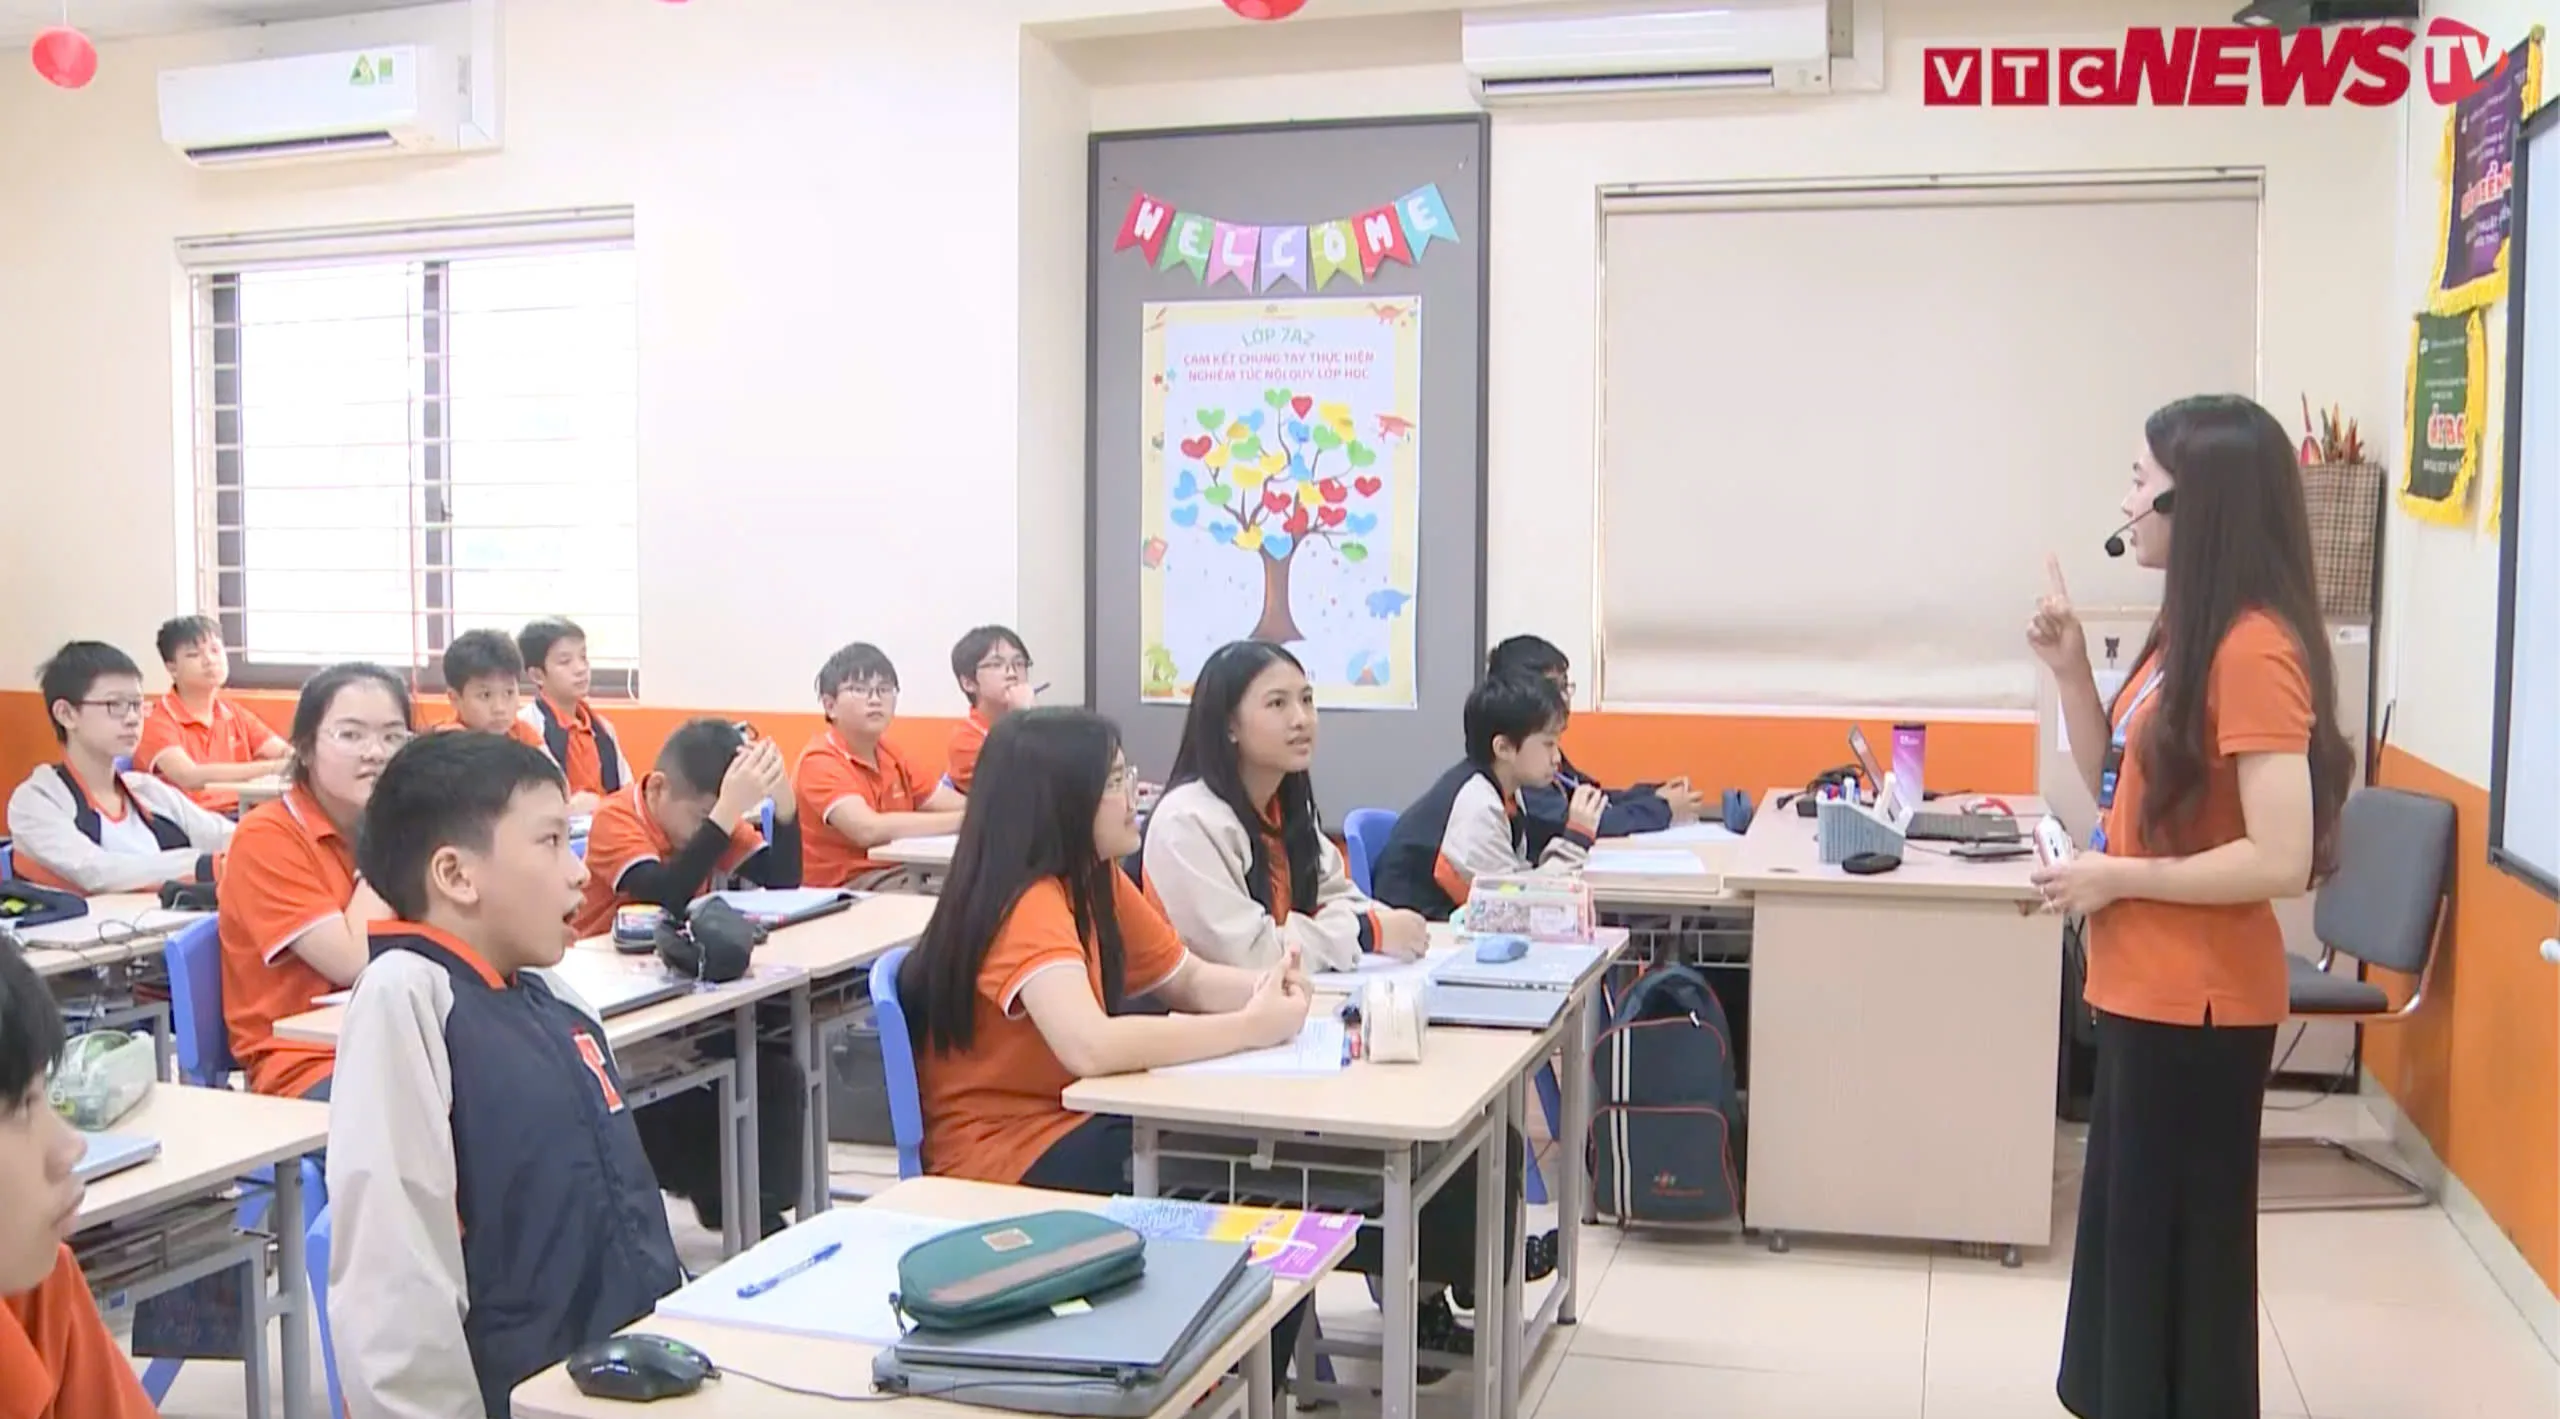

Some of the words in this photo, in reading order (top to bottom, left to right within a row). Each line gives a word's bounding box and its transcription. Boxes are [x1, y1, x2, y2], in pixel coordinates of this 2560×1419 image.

[1133, 194, 1438, 268] WELCOME
[1279, 326, 1316, 348] 7A2
[1239, 351, 1280, 365] CHUNG
[1284, 351, 1306, 364] TAY
